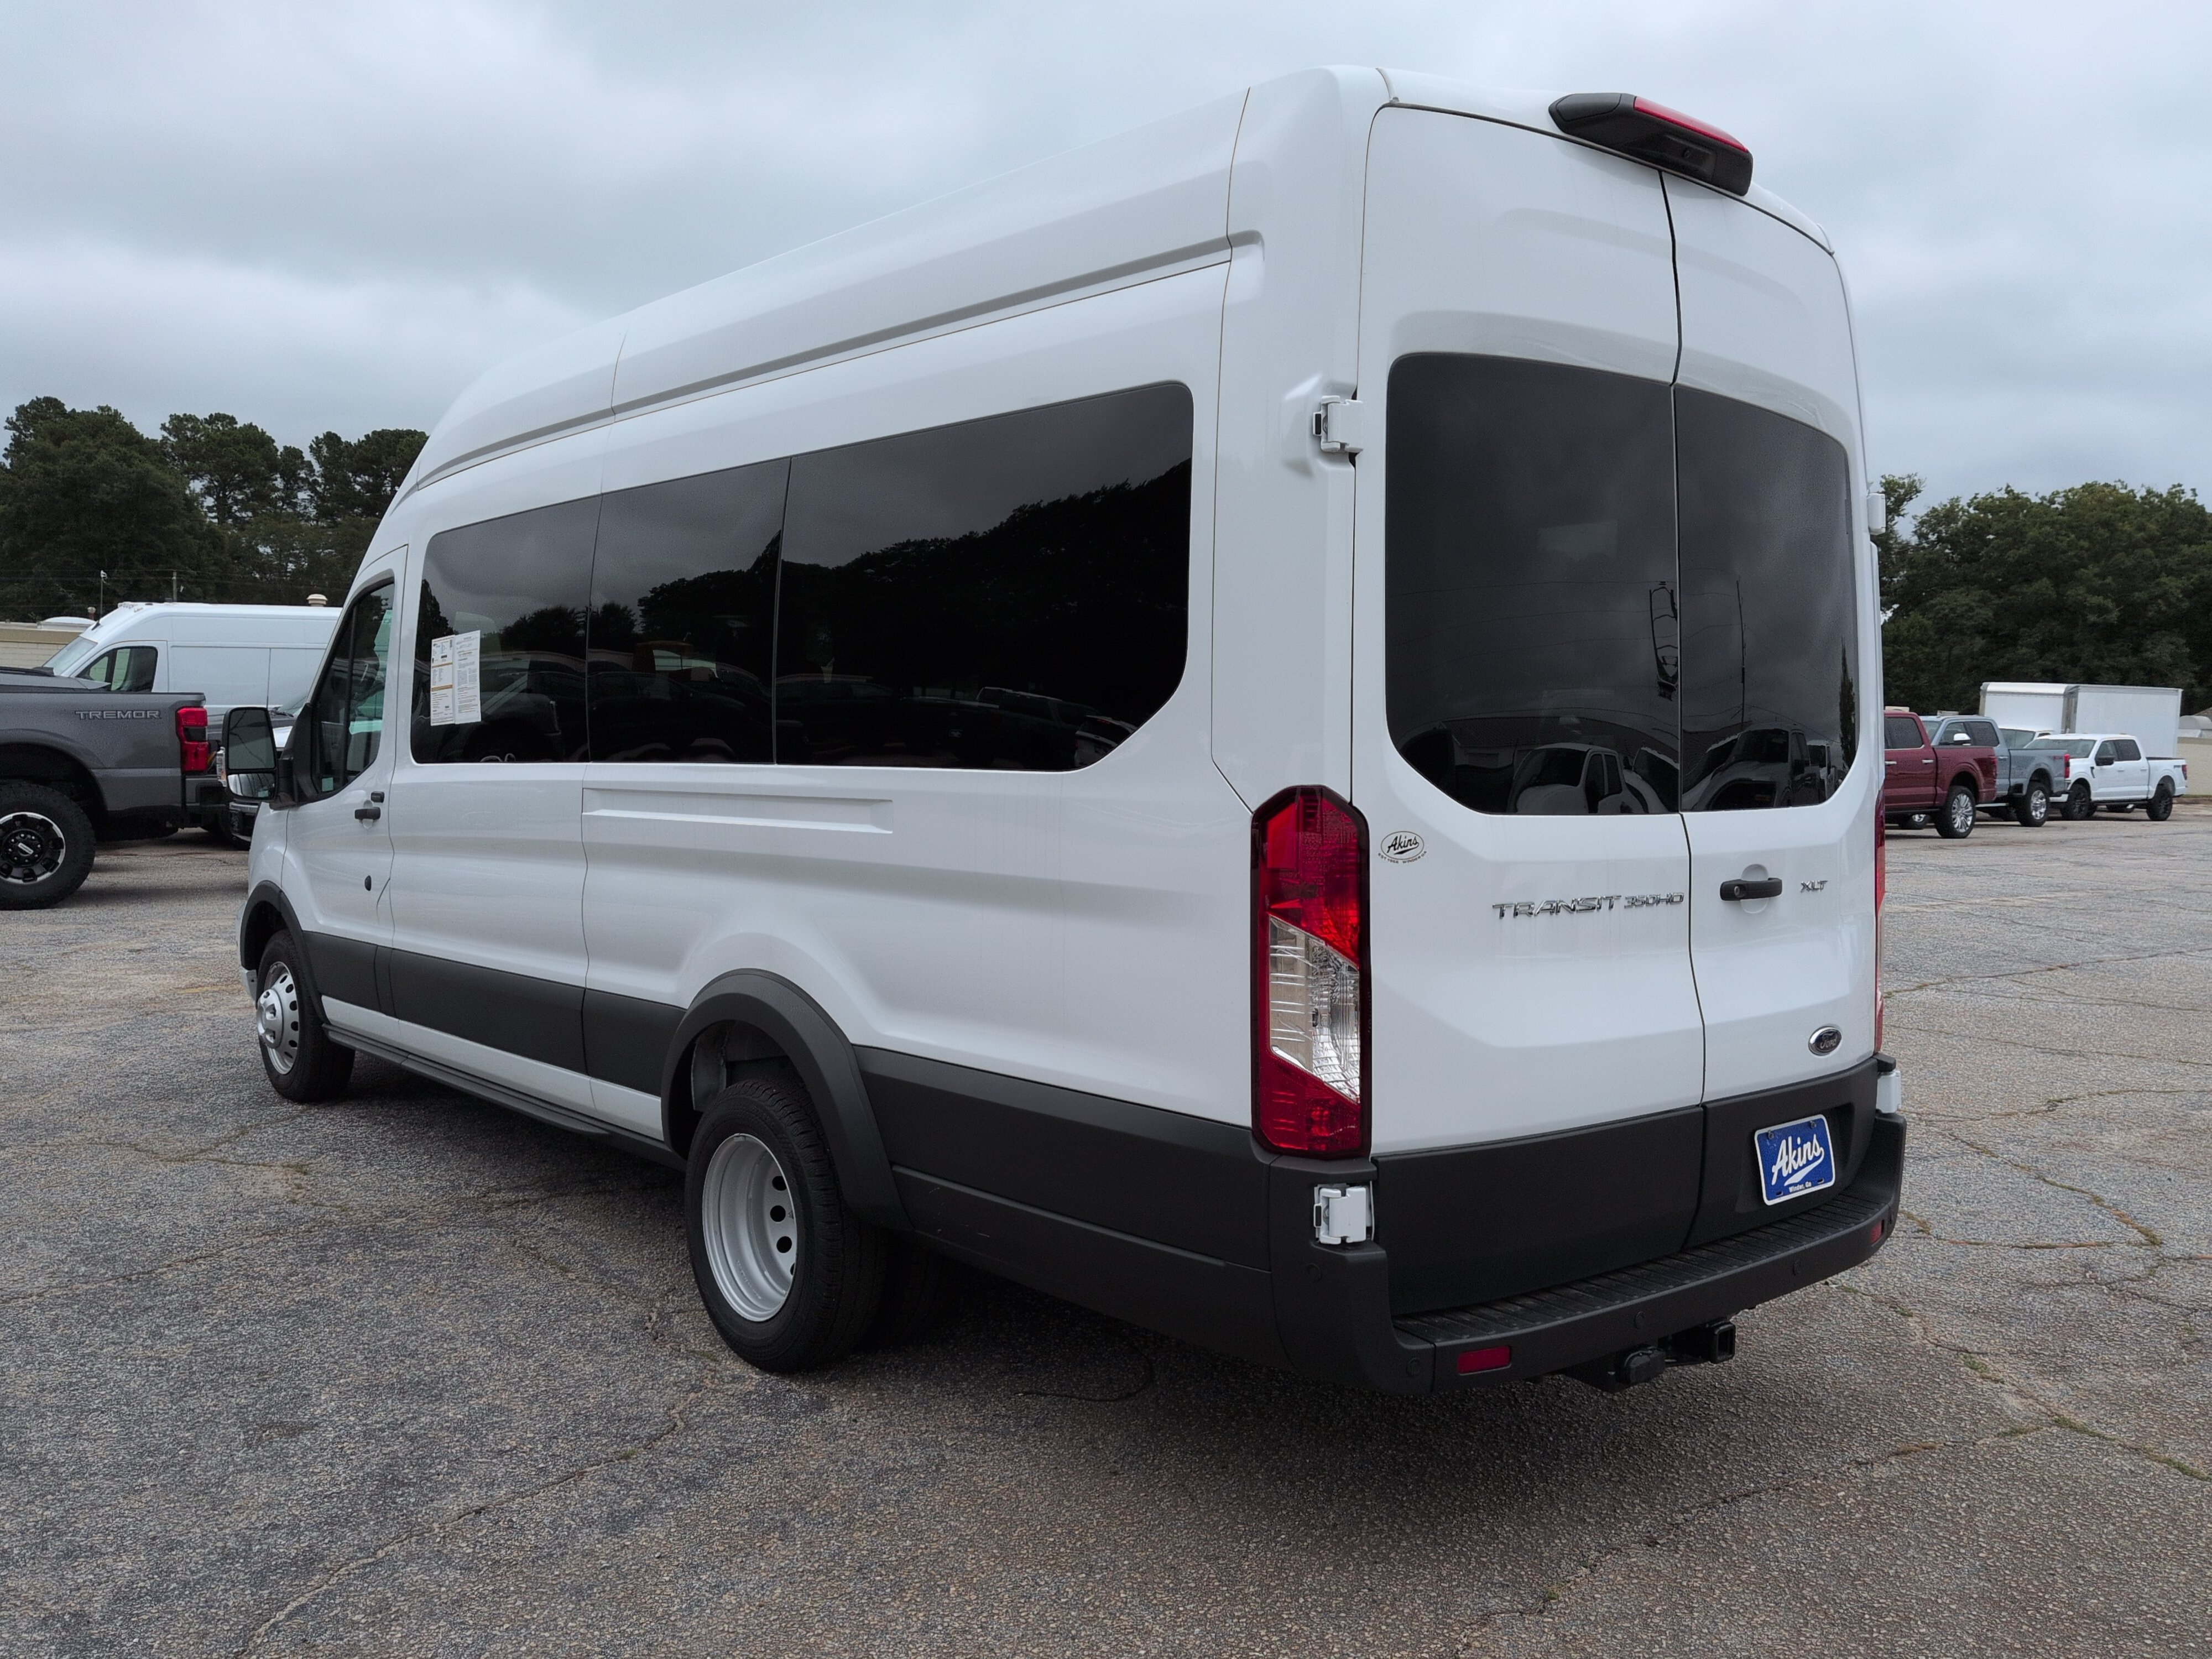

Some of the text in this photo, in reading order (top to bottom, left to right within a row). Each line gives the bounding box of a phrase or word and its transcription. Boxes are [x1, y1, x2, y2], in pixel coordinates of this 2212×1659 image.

[75, 711, 161, 719] TREMOR
[1386, 834, 1419, 855] Akins
[1800, 880, 1828, 893] XLT
[1493, 887, 1684, 919] TRANSIT 350HD
[1771, 1134, 1824, 1186] Akins
